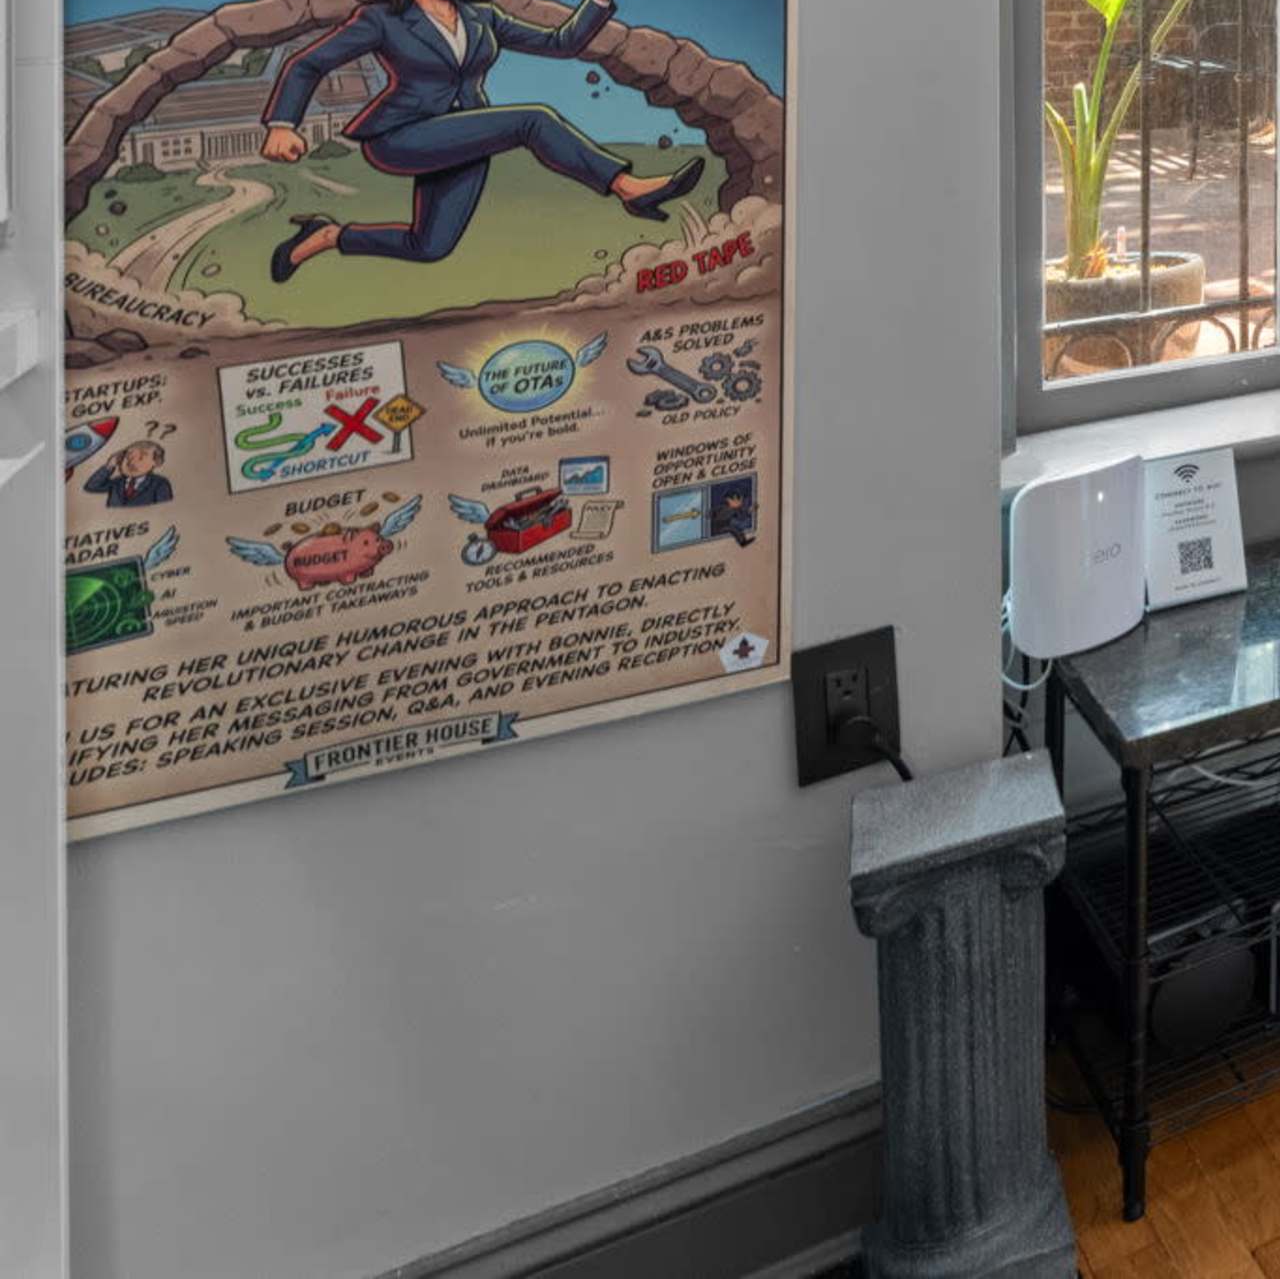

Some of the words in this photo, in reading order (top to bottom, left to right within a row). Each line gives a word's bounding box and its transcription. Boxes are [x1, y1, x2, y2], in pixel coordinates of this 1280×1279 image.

[636, 260, 689, 294] RED
[692, 231, 755, 274] TAPE
[65, 271, 216, 328] BUREAUCRACY
[246, 352, 365, 384] SUCCESSES
[279, 366, 374, 395] FAILURES
[280, 450, 372, 478] SHORTCUT
[285, 489, 367, 517] BUDGET
[177, 654, 228, 677] HER
[237, 634, 330, 665] UNIQUE
[336, 610, 468, 647] HUMOROUS
[473, 588, 588, 622] APPROACH
[598, 581, 623, 597] TO
[629, 562, 727, 593] ENACTING
[314, 730, 419, 771] FRONTIER
[426, 718, 493, 744] HOUSE
[374, 747, 436, 768] EVENTS
